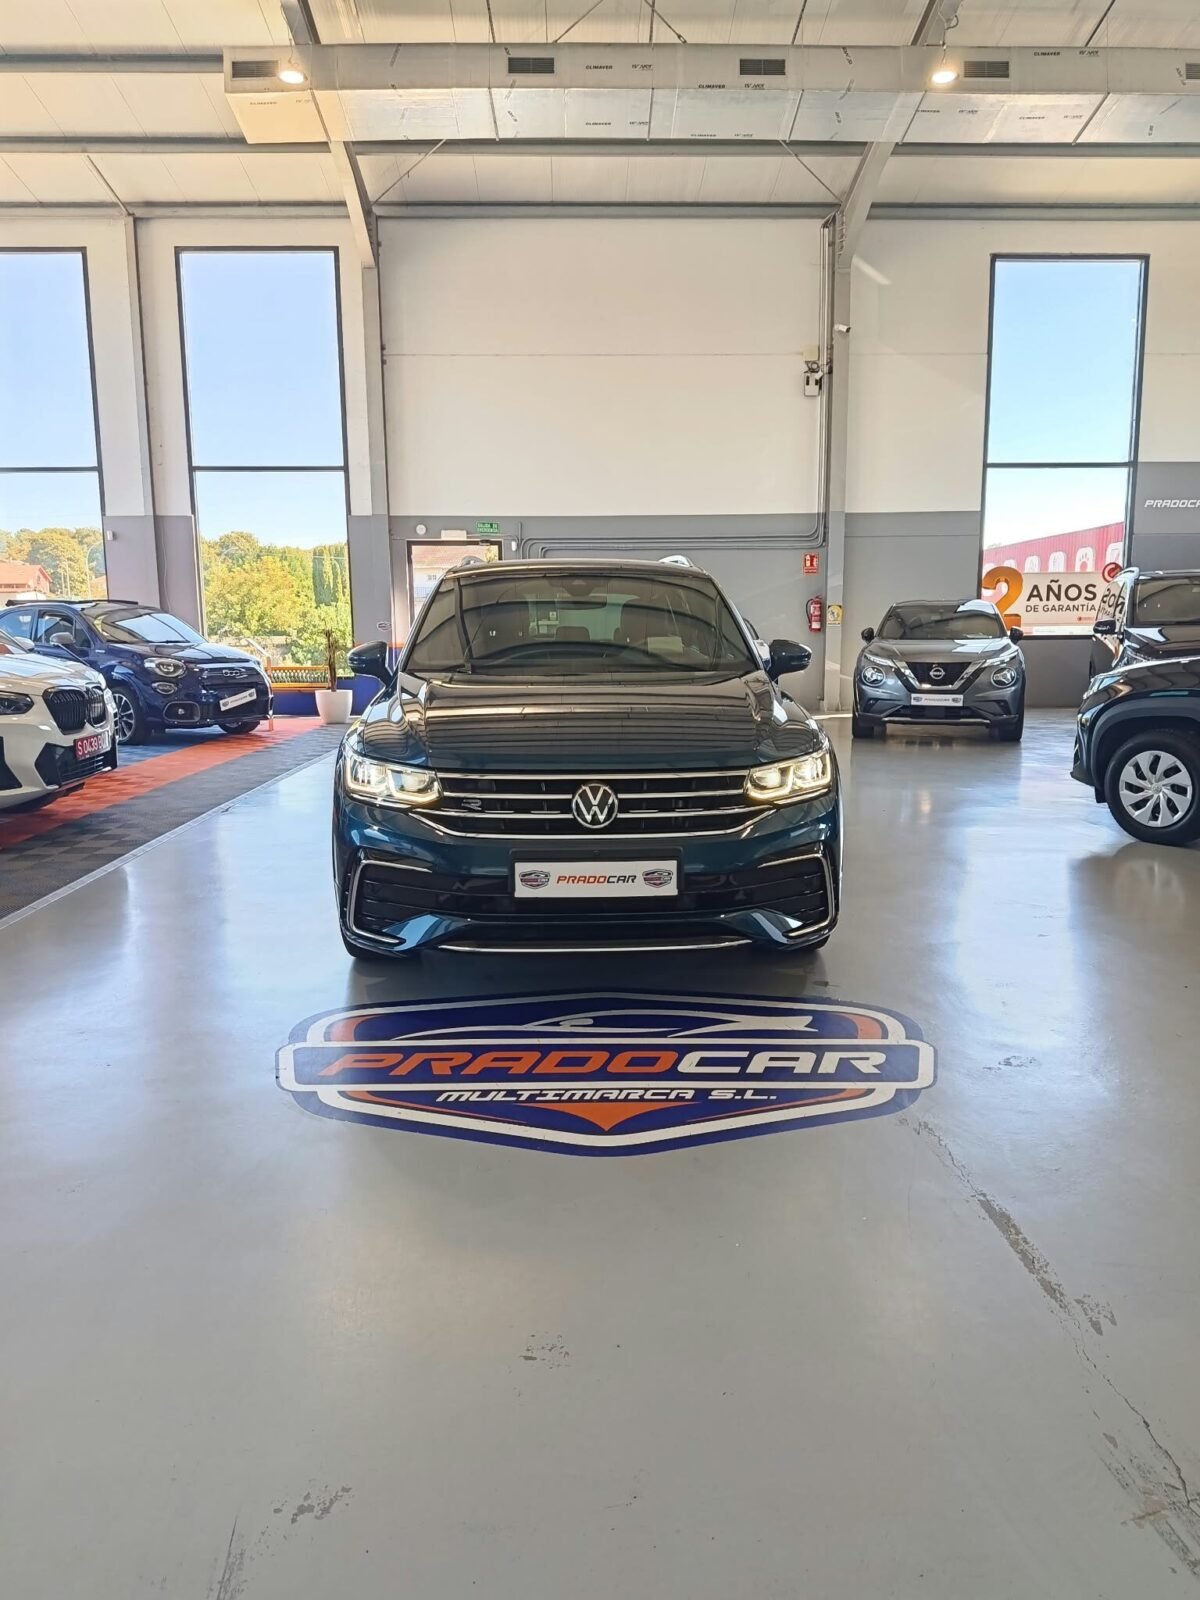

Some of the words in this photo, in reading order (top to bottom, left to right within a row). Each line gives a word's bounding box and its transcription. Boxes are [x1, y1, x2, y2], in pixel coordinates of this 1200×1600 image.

[981, 566, 1024, 632] 2
[1026, 579, 1097, 602] AÑOS
[1025, 604, 1040, 613] DE
[1042, 602, 1097, 613] GARANTÍA
[556, 875, 637, 884] PRADOCAR
[318, 1050, 887, 1077] PRADOCAR
[435, 1089, 695, 1103] MULTIMARCA
[707, 1089, 778, 1101] S.L.
